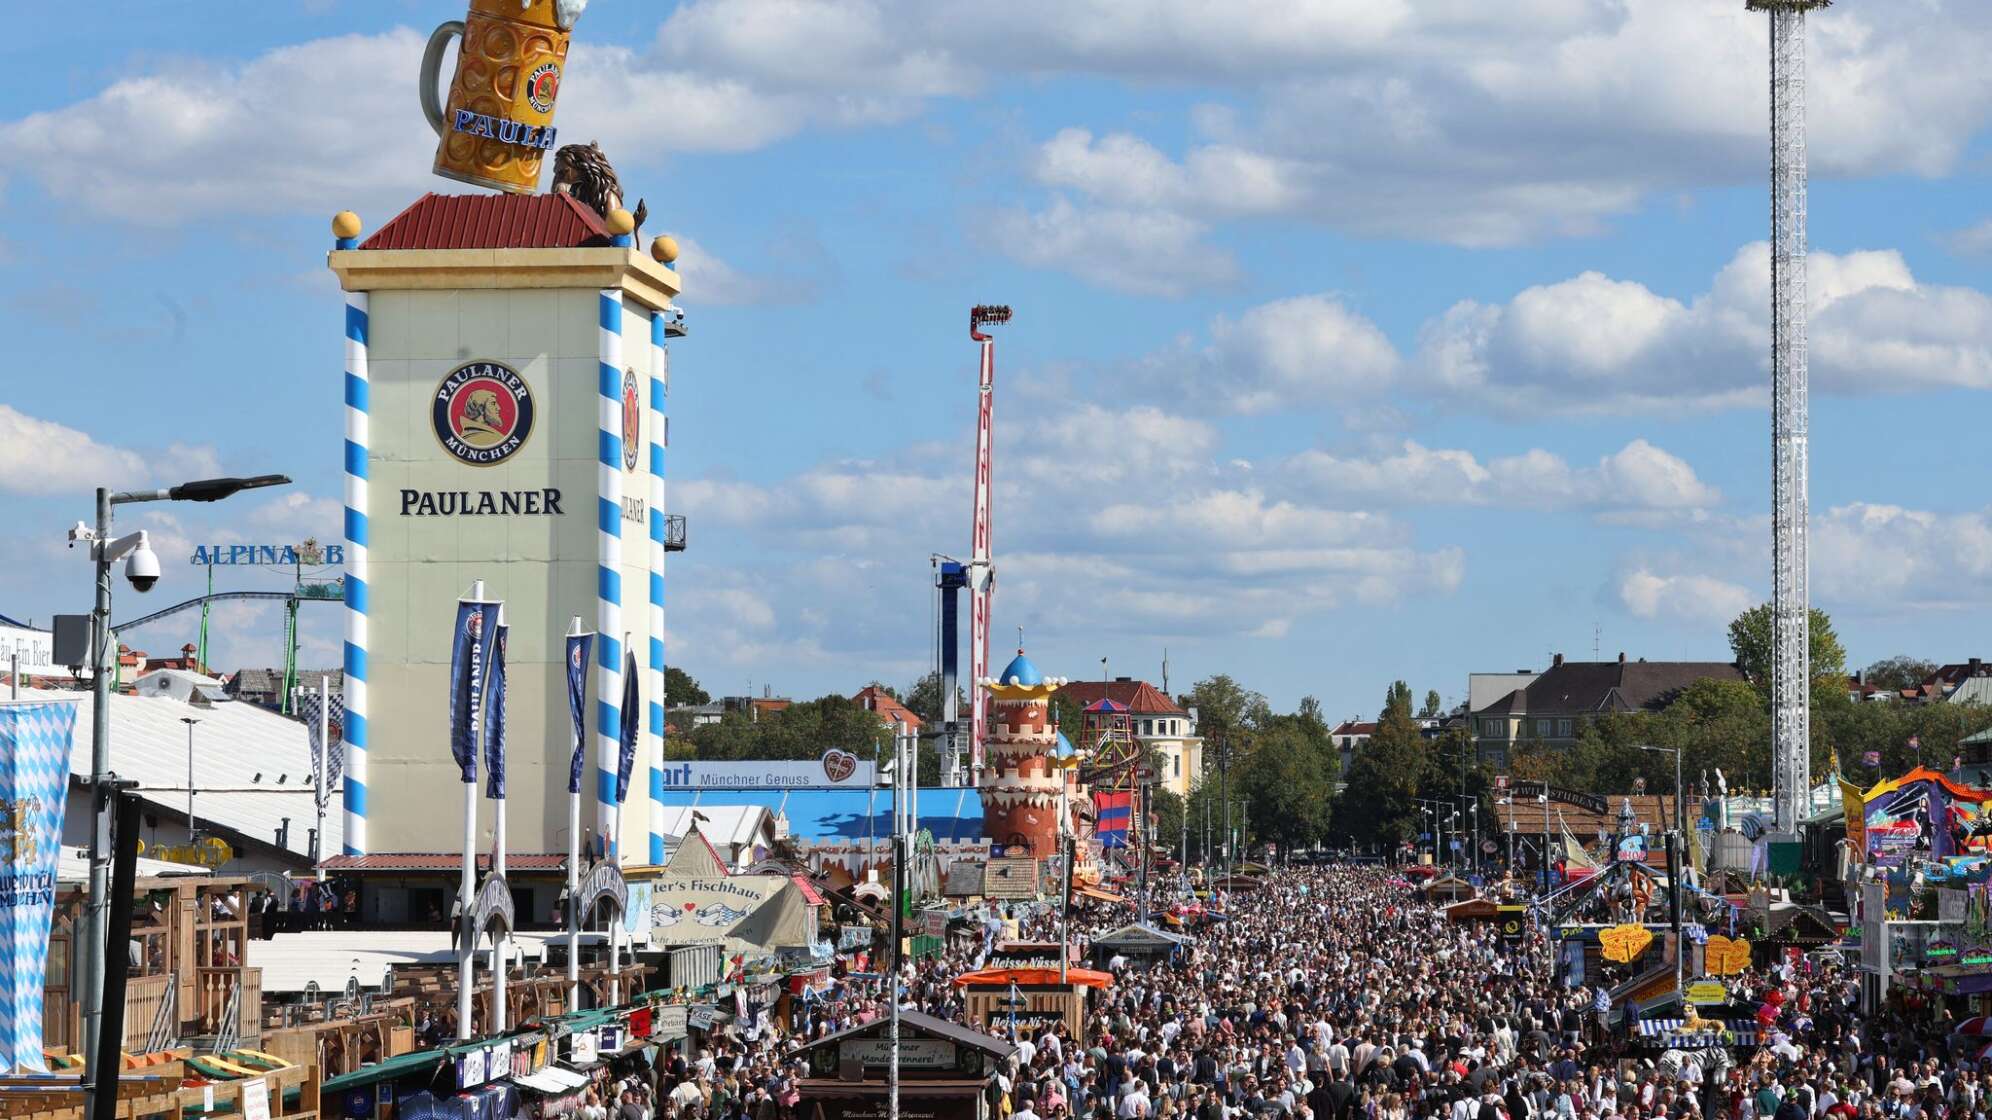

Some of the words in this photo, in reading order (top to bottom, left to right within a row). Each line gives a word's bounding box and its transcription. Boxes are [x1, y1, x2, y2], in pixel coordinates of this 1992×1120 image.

[454, 108, 557, 150] PAULA
[437, 364, 528, 403] PAULANER
[445, 435, 521, 462] MÜNCHEN
[399, 488, 565, 516] PAULANER
[190, 544, 298, 565] ALPINA
[33, 640, 50, 668] Bier
[700, 773, 760, 786] Münchner
[766, 773, 810, 786] Genuss
[653, 881, 687, 894] ter's
[690, 879, 762, 901] Fischhaus
[991, 956, 1028, 969] Heisse
[992, 1016, 1027, 1028] Heise
